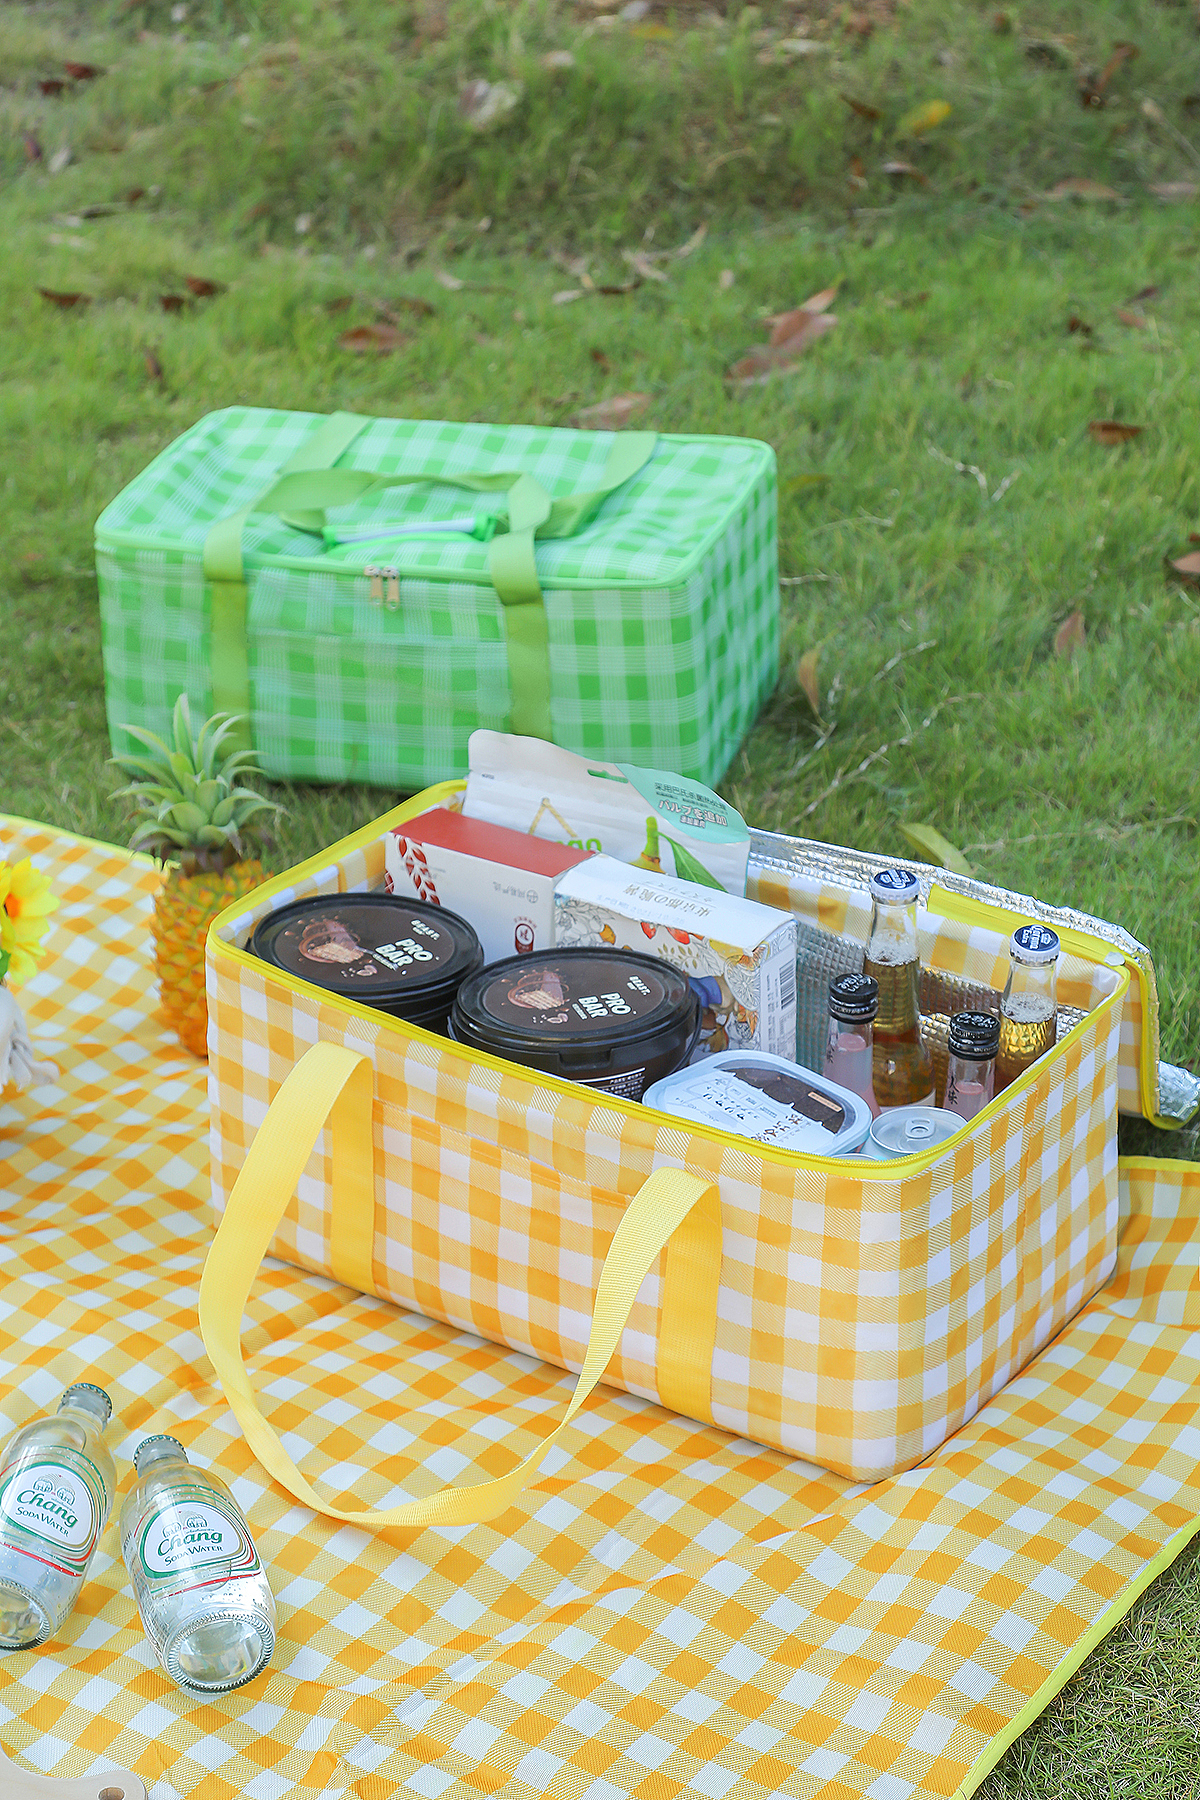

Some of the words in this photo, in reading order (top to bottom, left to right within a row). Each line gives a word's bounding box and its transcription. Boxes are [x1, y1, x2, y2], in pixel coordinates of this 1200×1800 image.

[375, 943, 414, 967] BAR
[395, 938, 433, 961] PRO
[578, 996, 609, 1019] BAR
[600, 992, 631, 1015] PRO
[17, 1489, 79, 1528] Chang
[15, 1506, 39, 1520] SODA
[41, 1512, 70, 1537] WATER
[157, 1531, 223, 1556] Chang
[164, 1551, 189, 1566] SODA
[188, 1545, 224, 1555] WATER
